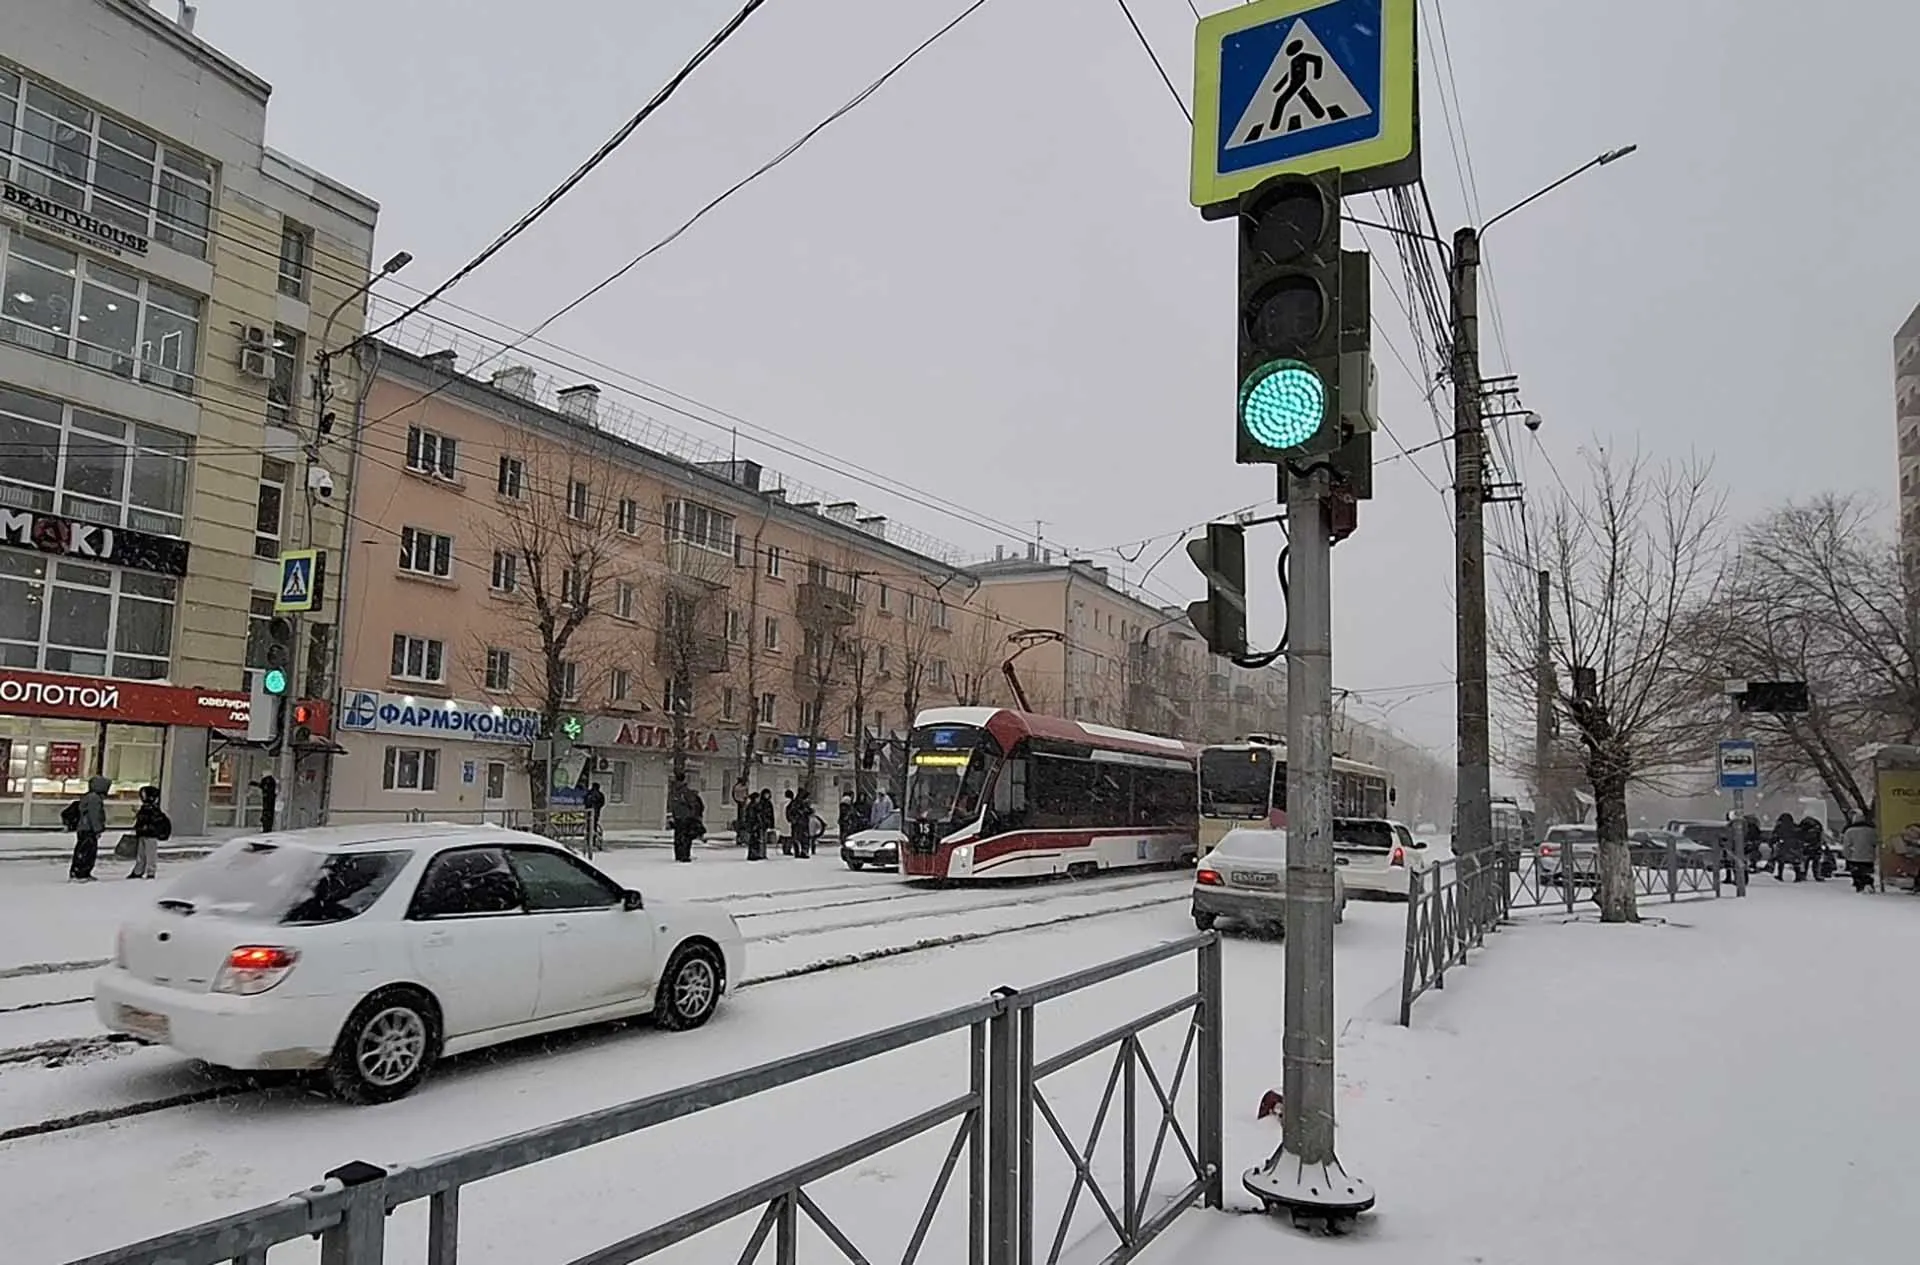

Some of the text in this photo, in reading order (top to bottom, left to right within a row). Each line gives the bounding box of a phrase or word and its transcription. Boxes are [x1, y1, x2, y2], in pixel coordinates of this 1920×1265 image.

[4, 184, 148, 253] BEAUTYHOUSE
[615, 723, 720, 752] АПТКА
[919, 823, 930, 834] 15
